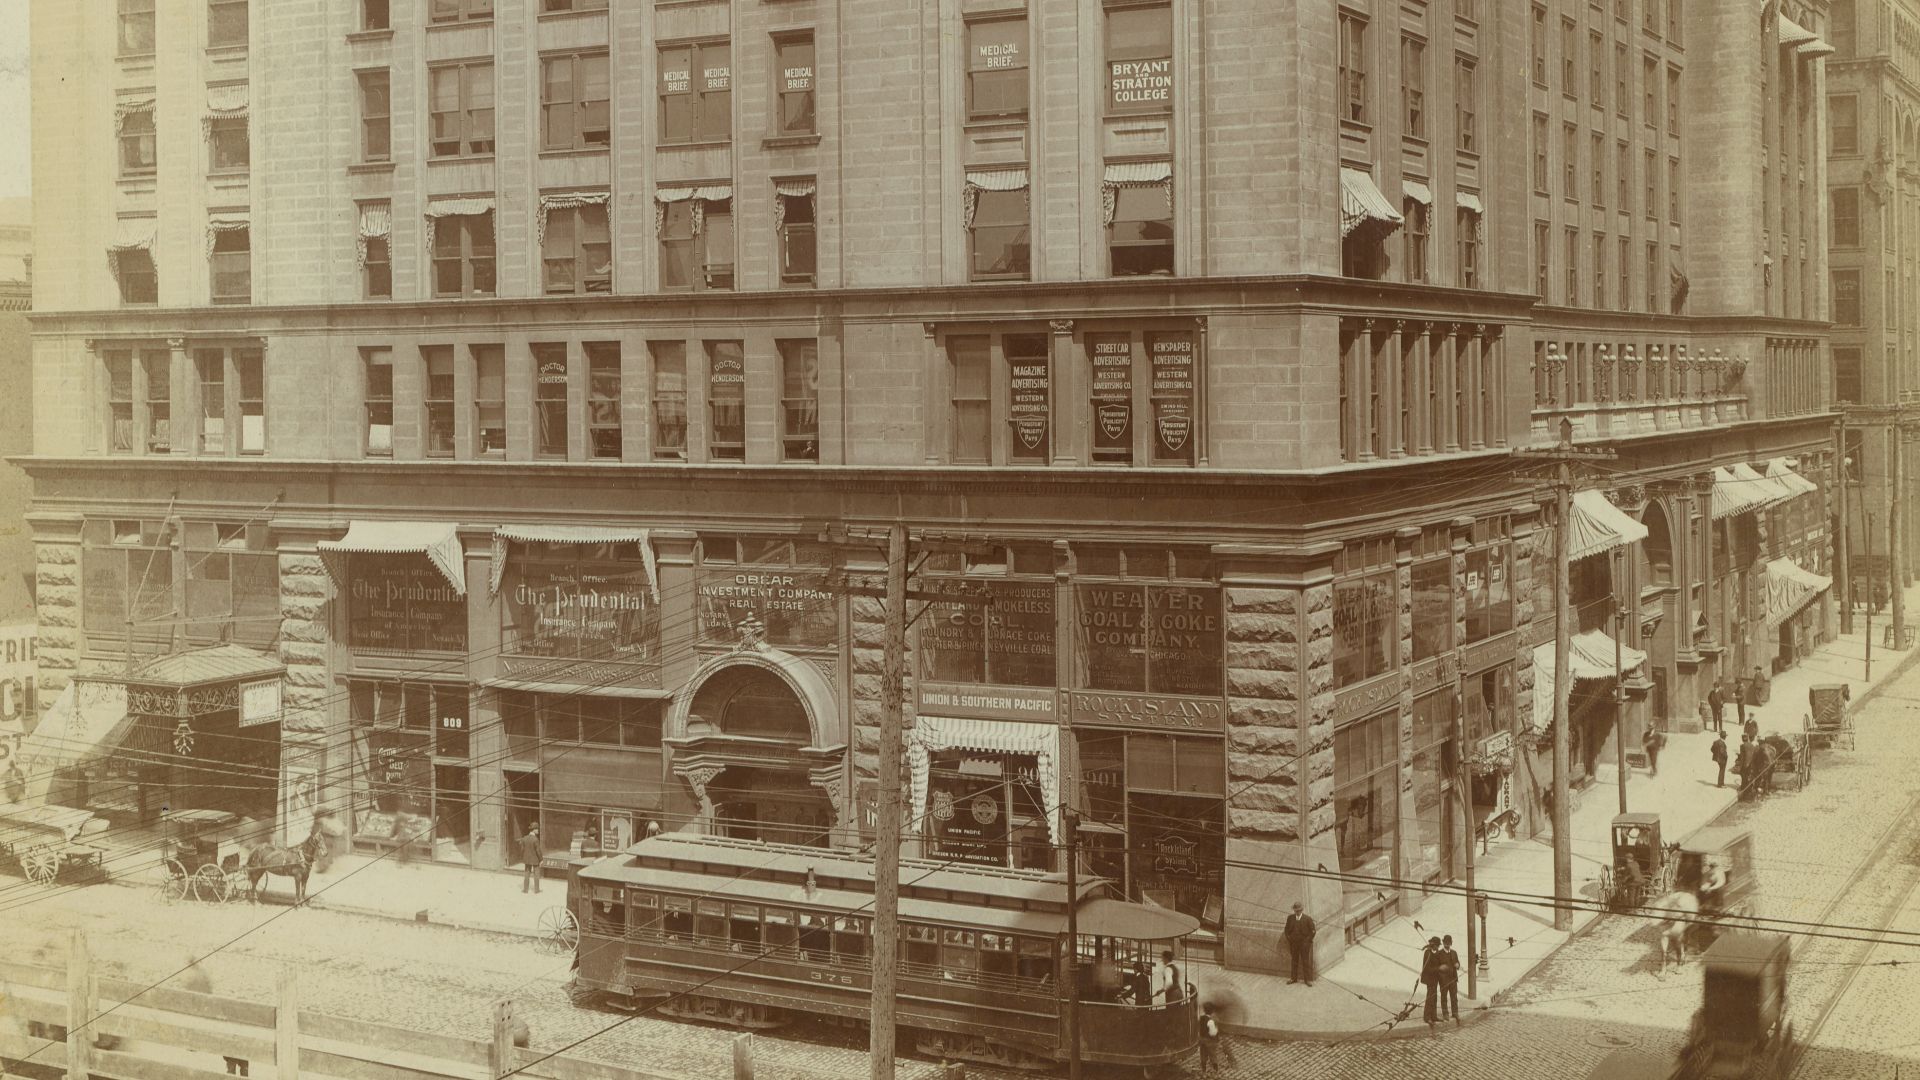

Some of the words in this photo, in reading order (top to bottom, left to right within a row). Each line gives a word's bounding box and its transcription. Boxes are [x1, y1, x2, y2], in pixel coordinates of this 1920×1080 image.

[980, 44, 1018, 56] MEDICAL
[987, 56, 1014, 68] BRIEF.
[704, 67, 731, 78] MEDICAL
[784, 67, 812, 78] MEDICAL
[1112, 61, 1170, 76] BRYANT
[664, 71, 690, 82] MEDICAL
[668, 82, 688, 92] BRIEF.
[708, 78, 728, 88] BRIEF.
[788, 78, 808, 89] BRIEF.
[1112, 76, 1172, 90] STRATTON
[1115, 89, 1168, 102] COLLEGE
[1096, 344, 1118, 354] STREET
[1118, 343, 1128, 353] CAR
[1154, 342, 1190, 352] NEWSPAPER
[1094, 356, 1130, 366] ADVERTISING
[1154, 354, 1192, 364] ADVERTISING
[540, 362, 565, 374] DOCTOR
[714, 360, 742, 372] DOCTOR
[1014, 366, 1046, 376] MAGAZINE
[1012, 378, 1048, 390] ADVERTISING
[1094, 382, 1123, 390] ADVERTISING
[1124, 382, 1132, 390] CO.
[1154, 381, 1184, 389] ADVERTISING
[1016, 394, 1044, 402] WESTERN
[1012, 404, 1040, 412] ADVERTISING
[1040, 404, 1048, 412] CO.
[1103, 417, 1126, 425] PUBLICITY
[1024, 434, 1038, 442] PAYS
[735, 574, 794, 585] OBEAR
[352, 578, 380, 599] The
[698, 586, 772, 598] INVESTMENT
[1004, 588, 1051, 599] PRODUCERS
[516, 584, 546, 606] The
[555, 586, 645, 616] Prudential
[730, 600, 756, 608] REAL
[1091, 590, 1203, 610] WEAVER
[988, 600, 1051, 614] SMOKELESS
[372, 604, 404, 618] Insurance
[410, 608, 442, 623] Company
[540, 612, 576, 627] Insurance
[582, 616, 618, 632] Company
[1140, 614, 1154, 628] &
[922, 628, 964, 638] FOUNDRY
[967, 629, 974, 638] &
[981, 628, 1023, 640] FURNACE
[922, 693, 949, 705] UNION
[952, 695, 959, 705] &
[961, 695, 1012, 709] SOUTHERN
[1014, 698, 1051, 711] PACIFIC
[1076, 696, 1132, 713] ROCK
[1136, 699, 1220, 718] ISLAND
[1098, 713, 1203, 727] SYSTEM.
[1086, 770, 1117, 788] 901
[810, 971, 852, 984] 376
